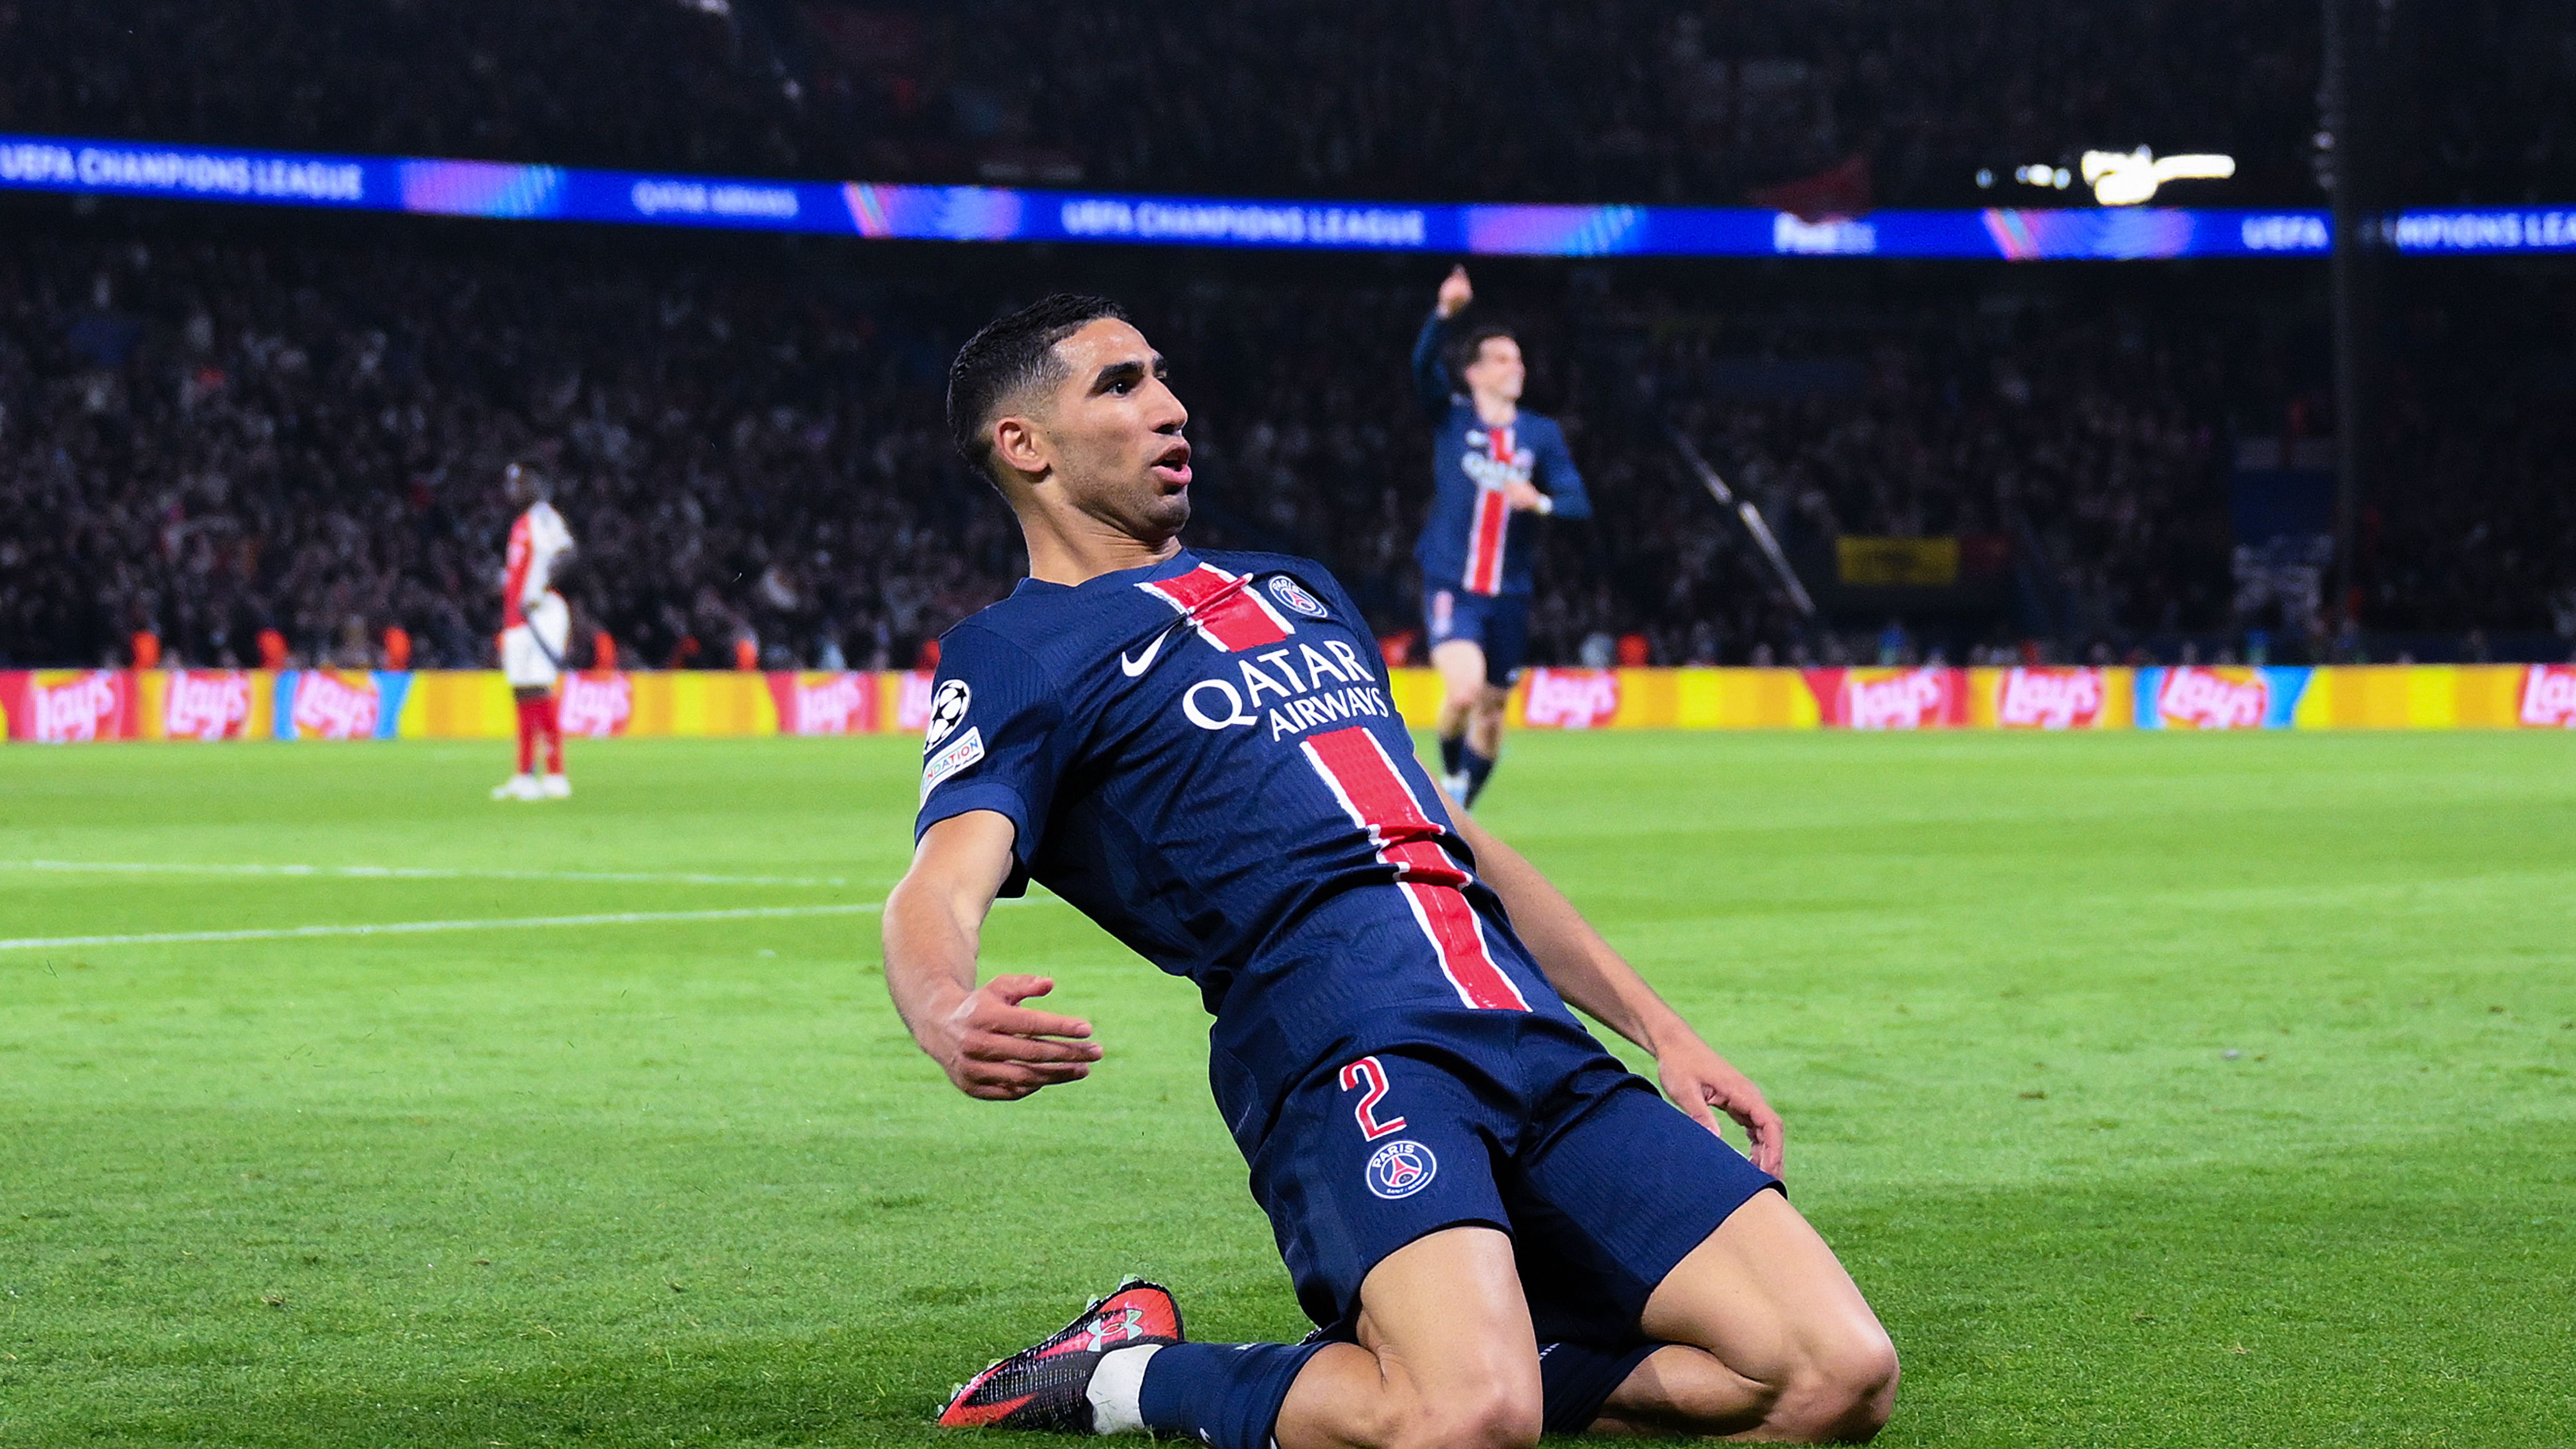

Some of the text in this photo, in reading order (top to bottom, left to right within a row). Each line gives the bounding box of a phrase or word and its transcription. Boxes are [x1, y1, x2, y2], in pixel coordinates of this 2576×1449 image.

[0, 144, 363, 201] UEFA CHAMPIONS LEAGUE
[1061, 200, 1424, 246] UEFA CHAMPIONS LEAGUE
[2242, 215, 2329, 250] UEFA
[1182, 640, 1376, 730] QATAR
[1269, 687, 1389, 742] AIRWAYS
[927, 738, 979, 778] NDATION
[1340, 1056, 1407, 1142] 2
[1372, 1144, 1415, 1168] PARIS
